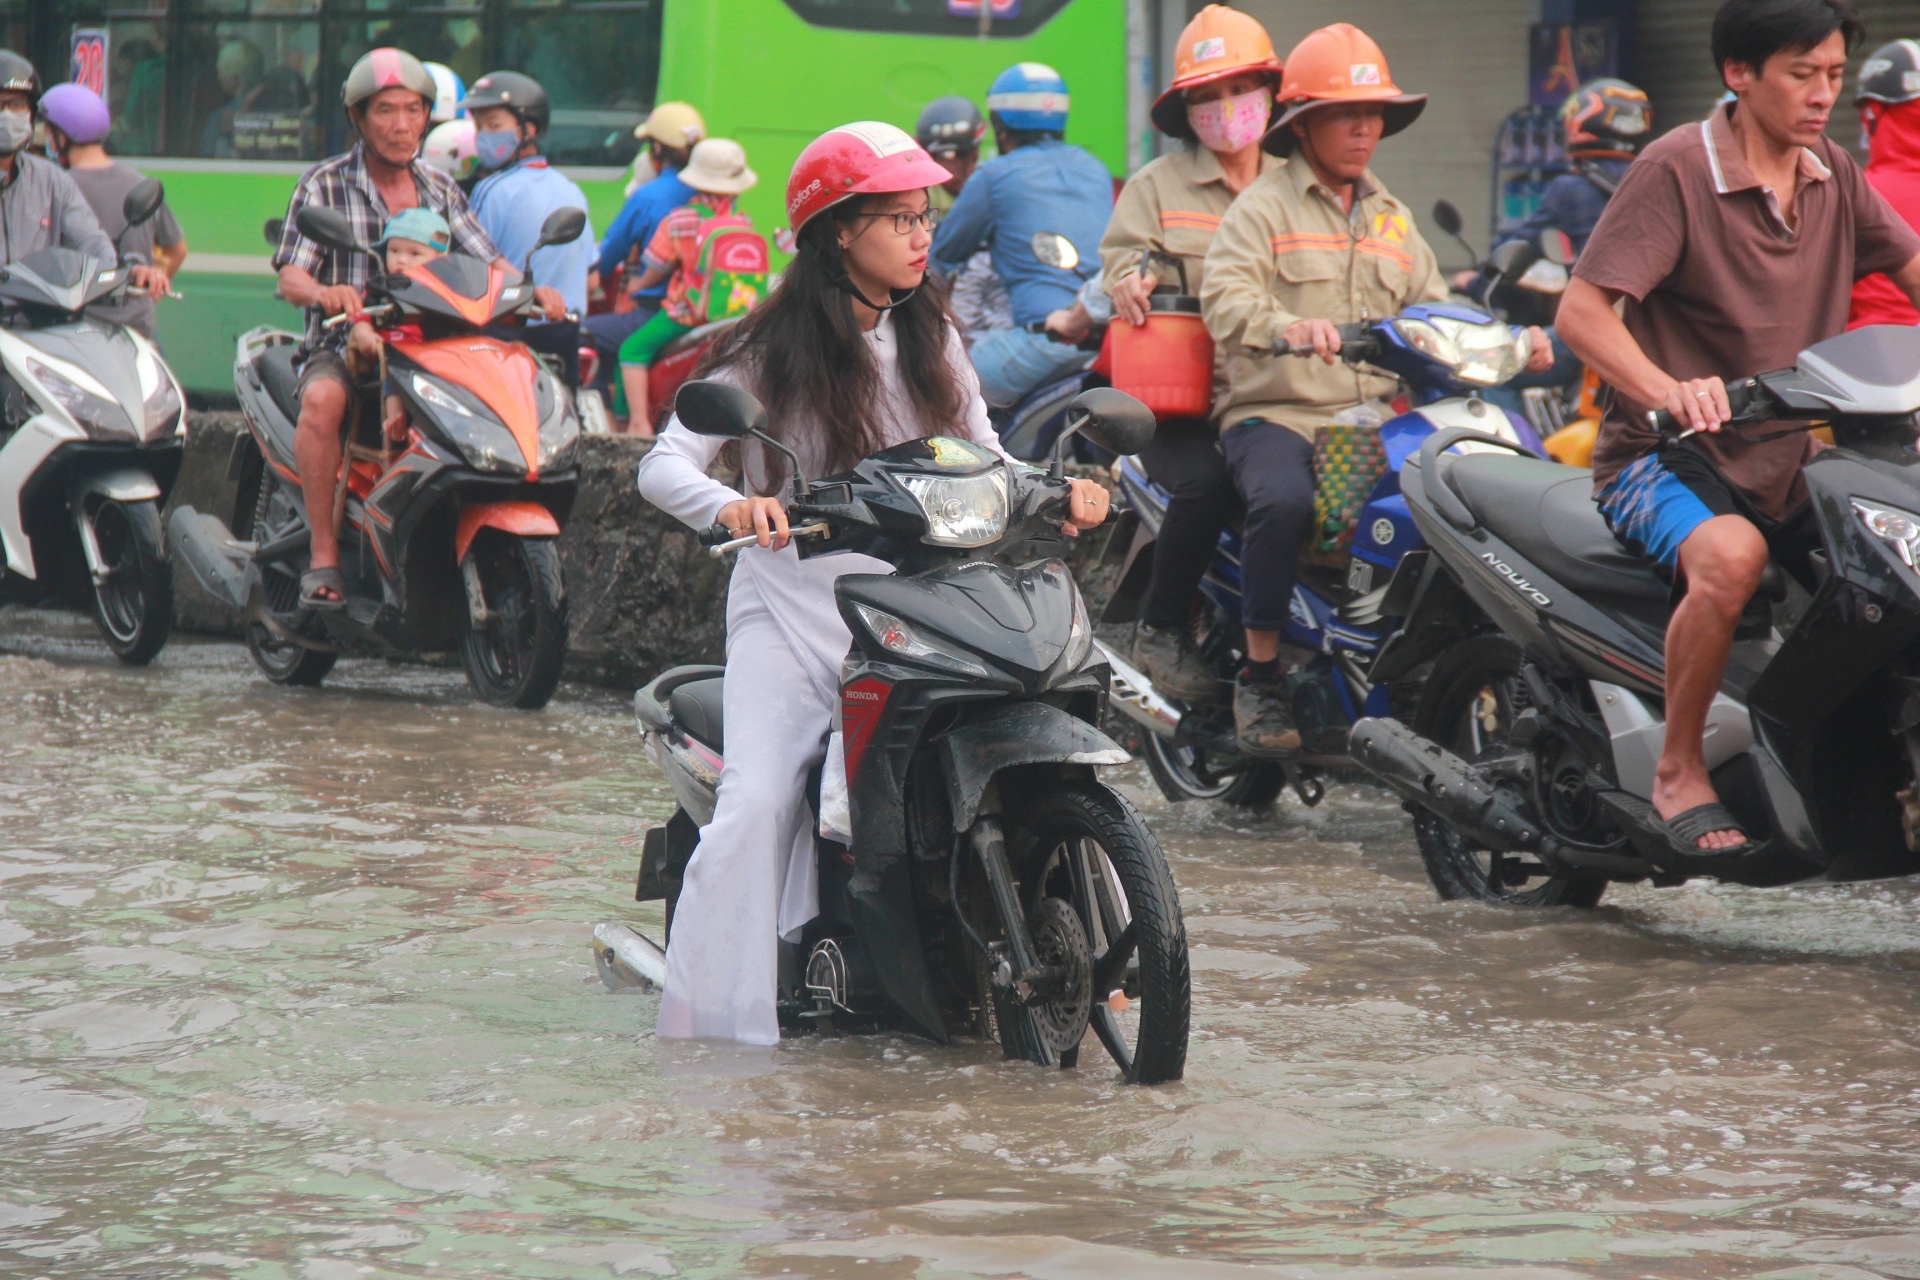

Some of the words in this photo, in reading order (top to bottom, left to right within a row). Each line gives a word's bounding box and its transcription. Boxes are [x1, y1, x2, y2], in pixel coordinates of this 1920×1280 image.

[957, 561, 998, 571] HONDA
[1482, 552, 1551, 606] NOUVO
[846, 690, 879, 701] HONDA
